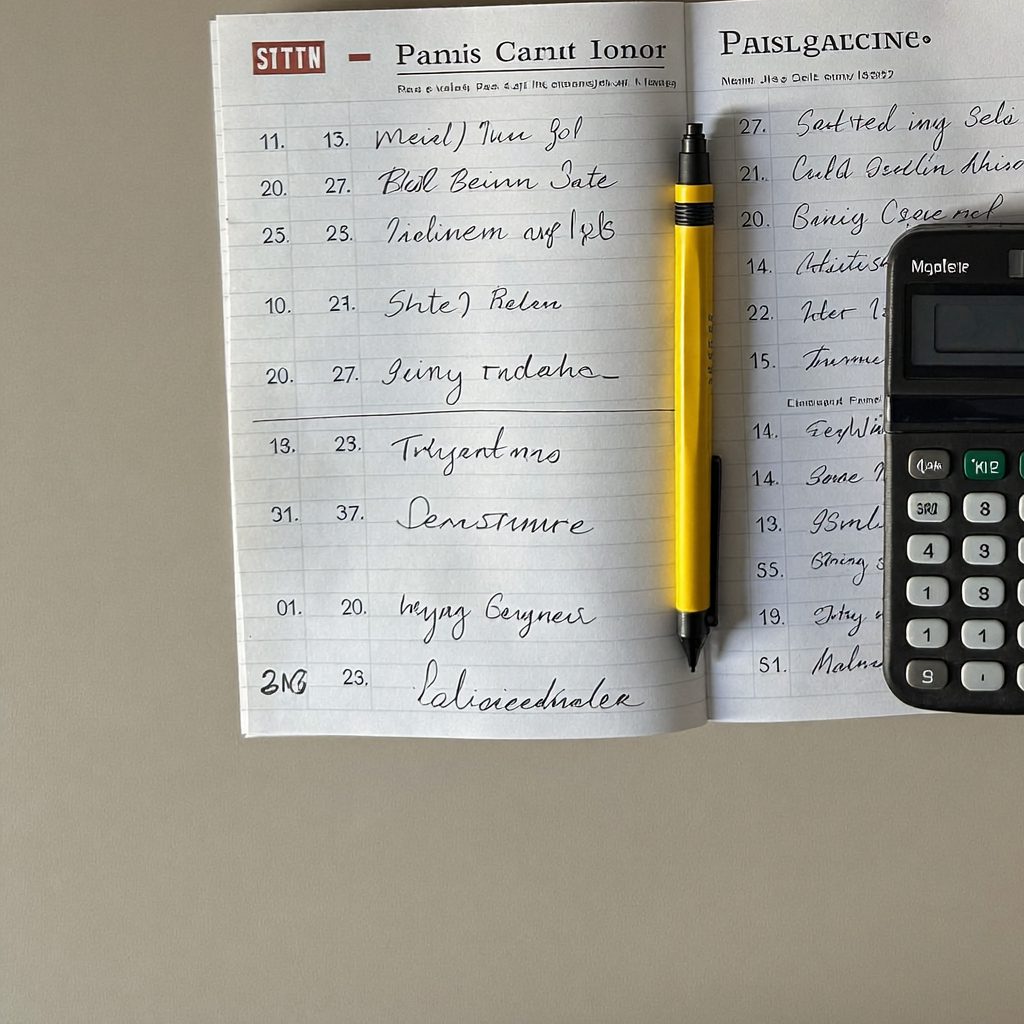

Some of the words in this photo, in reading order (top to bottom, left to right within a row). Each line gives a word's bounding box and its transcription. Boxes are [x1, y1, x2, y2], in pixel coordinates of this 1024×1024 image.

[739, 117, 767, 136] 27.
[258, 133, 286, 151] 11.
[322, 130, 350, 148] 13.
[260, 180, 288, 198] 20.
[325, 177, 352, 195] 27.
[740, 211, 771, 229] 20.
[262, 227, 290, 245] 25.
[325, 225, 354, 243] 23.
[745, 258, 773, 275] 14.
[264, 297, 293, 315] 10.
[746, 304, 775, 322] 22.
[749, 352, 777, 370] 15.
[266, 367, 295, 385] 20.
[332, 365, 360, 383] 27.
[751, 422, 780, 440] 14.
[334, 435, 363, 453] 23.
[751, 469, 781, 487] 14.
[271, 505, 300, 523] 31.
[336, 504, 365, 522] 37.
[755, 515, 783, 533] 13.
[922, 542, 935, 559] 4
[922, 585, 931, 601] 1
[276, 599, 303, 617] 01.
[341, 597, 368, 616] 20.
[758, 608, 787, 627] 19.
[922, 627, 931, 643] 1
[977, 628, 987, 644] 1
